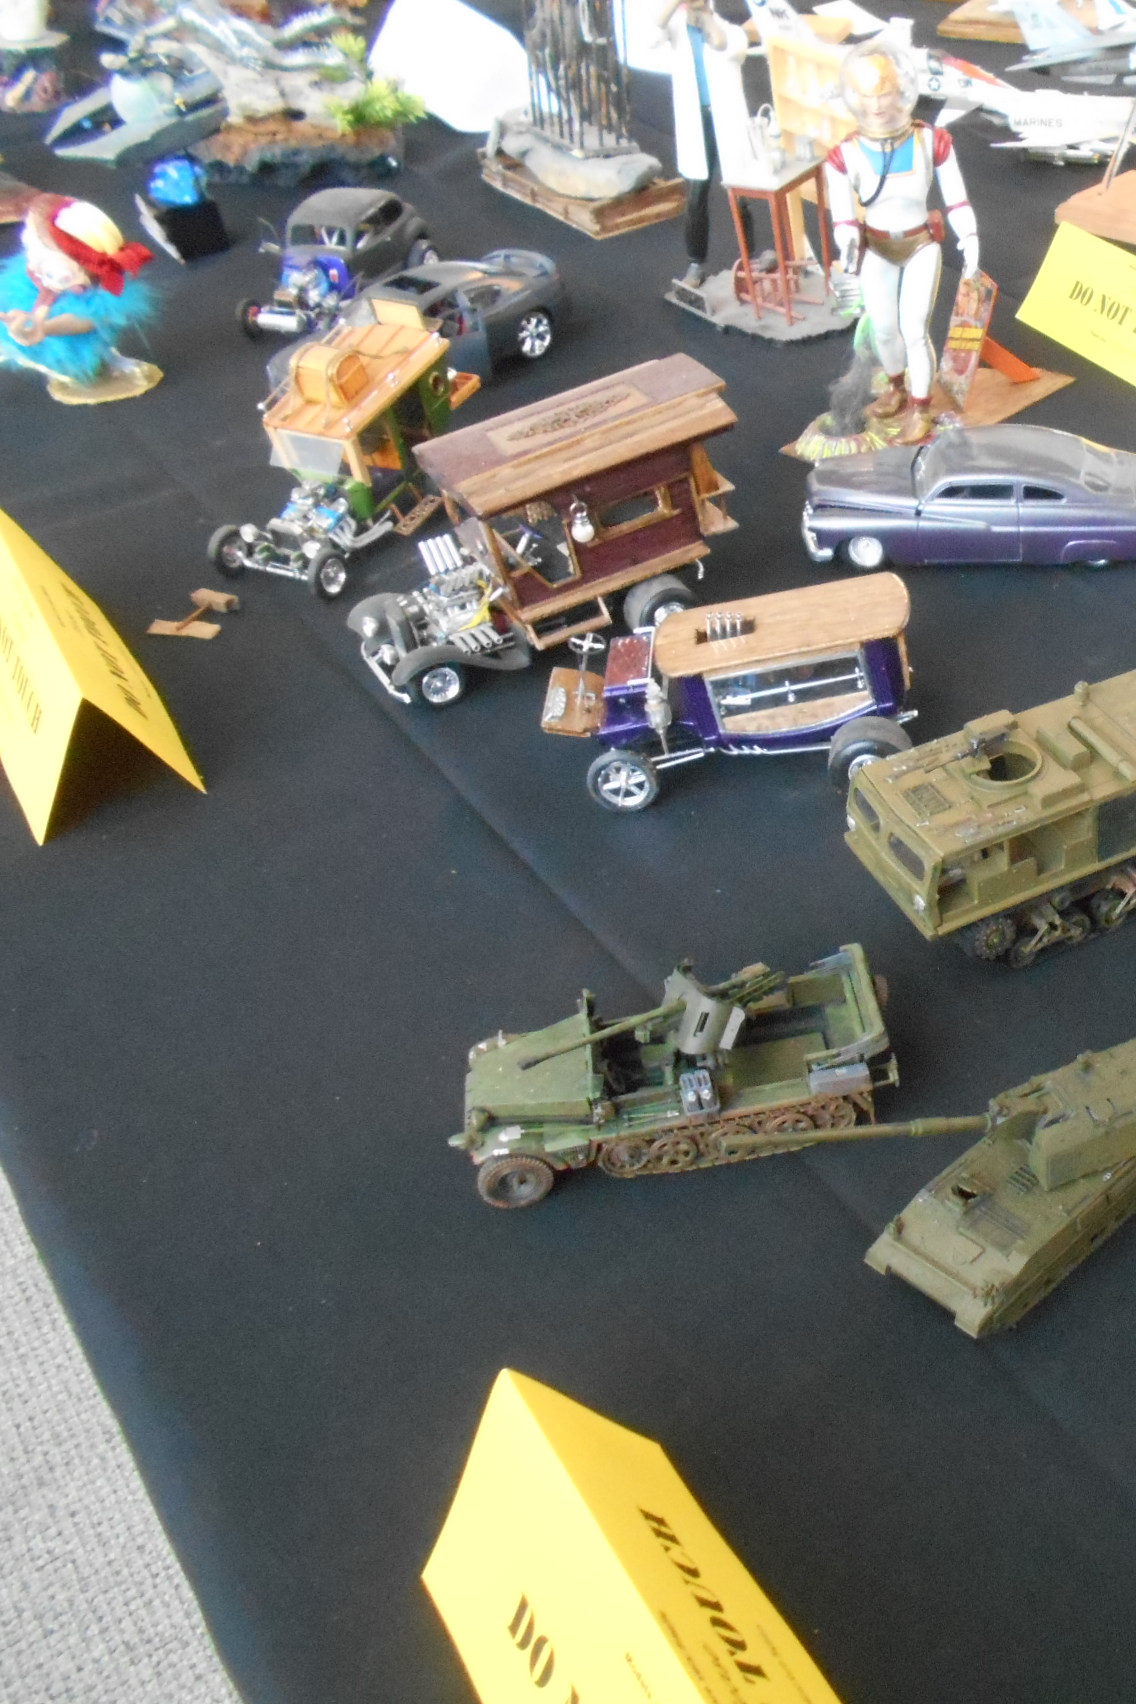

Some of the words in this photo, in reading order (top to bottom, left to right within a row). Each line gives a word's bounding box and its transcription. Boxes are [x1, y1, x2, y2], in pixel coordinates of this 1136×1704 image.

[1013, 117, 1063, 128] MARINES
[1068, 280, 1095, 307] DO
[1094, 293, 1133, 327] NOT
[507, 1592, 556, 1689] DO
